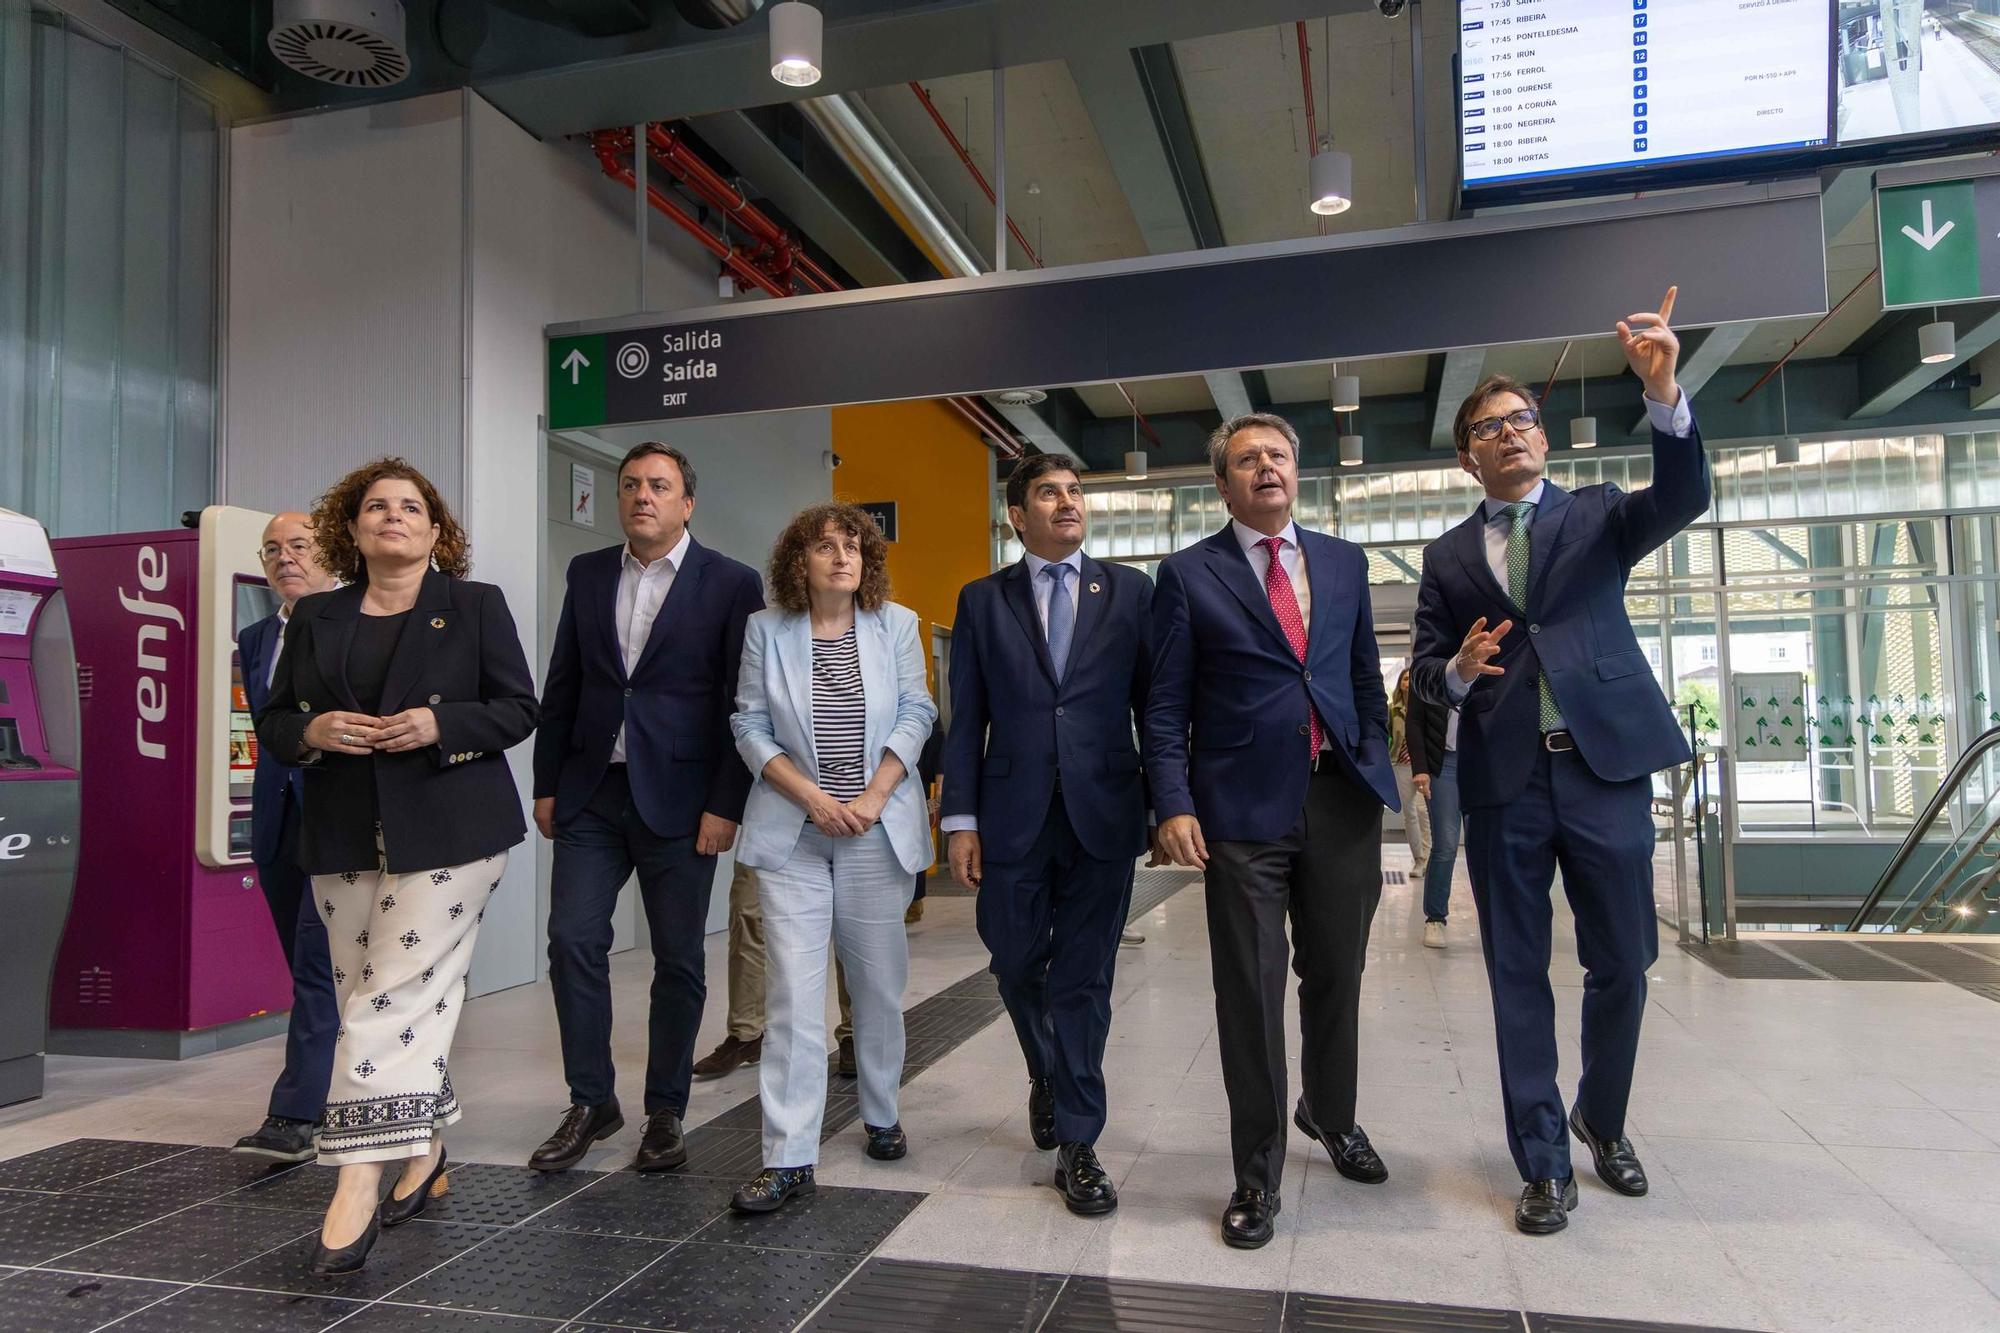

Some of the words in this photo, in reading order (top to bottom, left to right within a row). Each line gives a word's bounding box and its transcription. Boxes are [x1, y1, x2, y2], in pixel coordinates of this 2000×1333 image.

[1490, 0, 1511, 9] 17:30
[1491, 19, 1511, 27] 17:45
[1516, 13, 1546, 24] RIBEIRA
[1491, 36, 1511, 44] 17:45
[1516, 26, 1578, 41] PONTELEDESMA
[1635, 16, 1645, 25] 17
[1491, 53, 1512, 62] 17:45
[1635, 34, 1645, 43] 18
[1492, 70, 1512, 79] 17:56
[1517, 66, 1546, 76] FERROL
[1635, 52, 1645, 61] 12
[1492, 87, 1512, 97] 18:00
[1517, 82, 1553, 93] OURENSE
[1492, 105, 1512, 114] 18:00
[1524, 98, 1557, 109] CORUÑA
[1493, 122, 1513, 131] 18:00
[1518, 116, 1556, 128] NEGREIRA
[1493, 139, 1513, 148] 18:00
[1518, 135, 1548, 145] RIBEIRA
[1756, 107, 1784, 116] DIRECTO
[1493, 157, 1513, 165] 18:00
[1518, 152, 1549, 163] HORTAS
[1636, 141, 1646, 149] 16
[663, 329, 722, 353] Salida
[663, 359, 718, 382] Saída
[663, 392, 688, 406] EXIT
[118, 545, 185, 760] renfe
